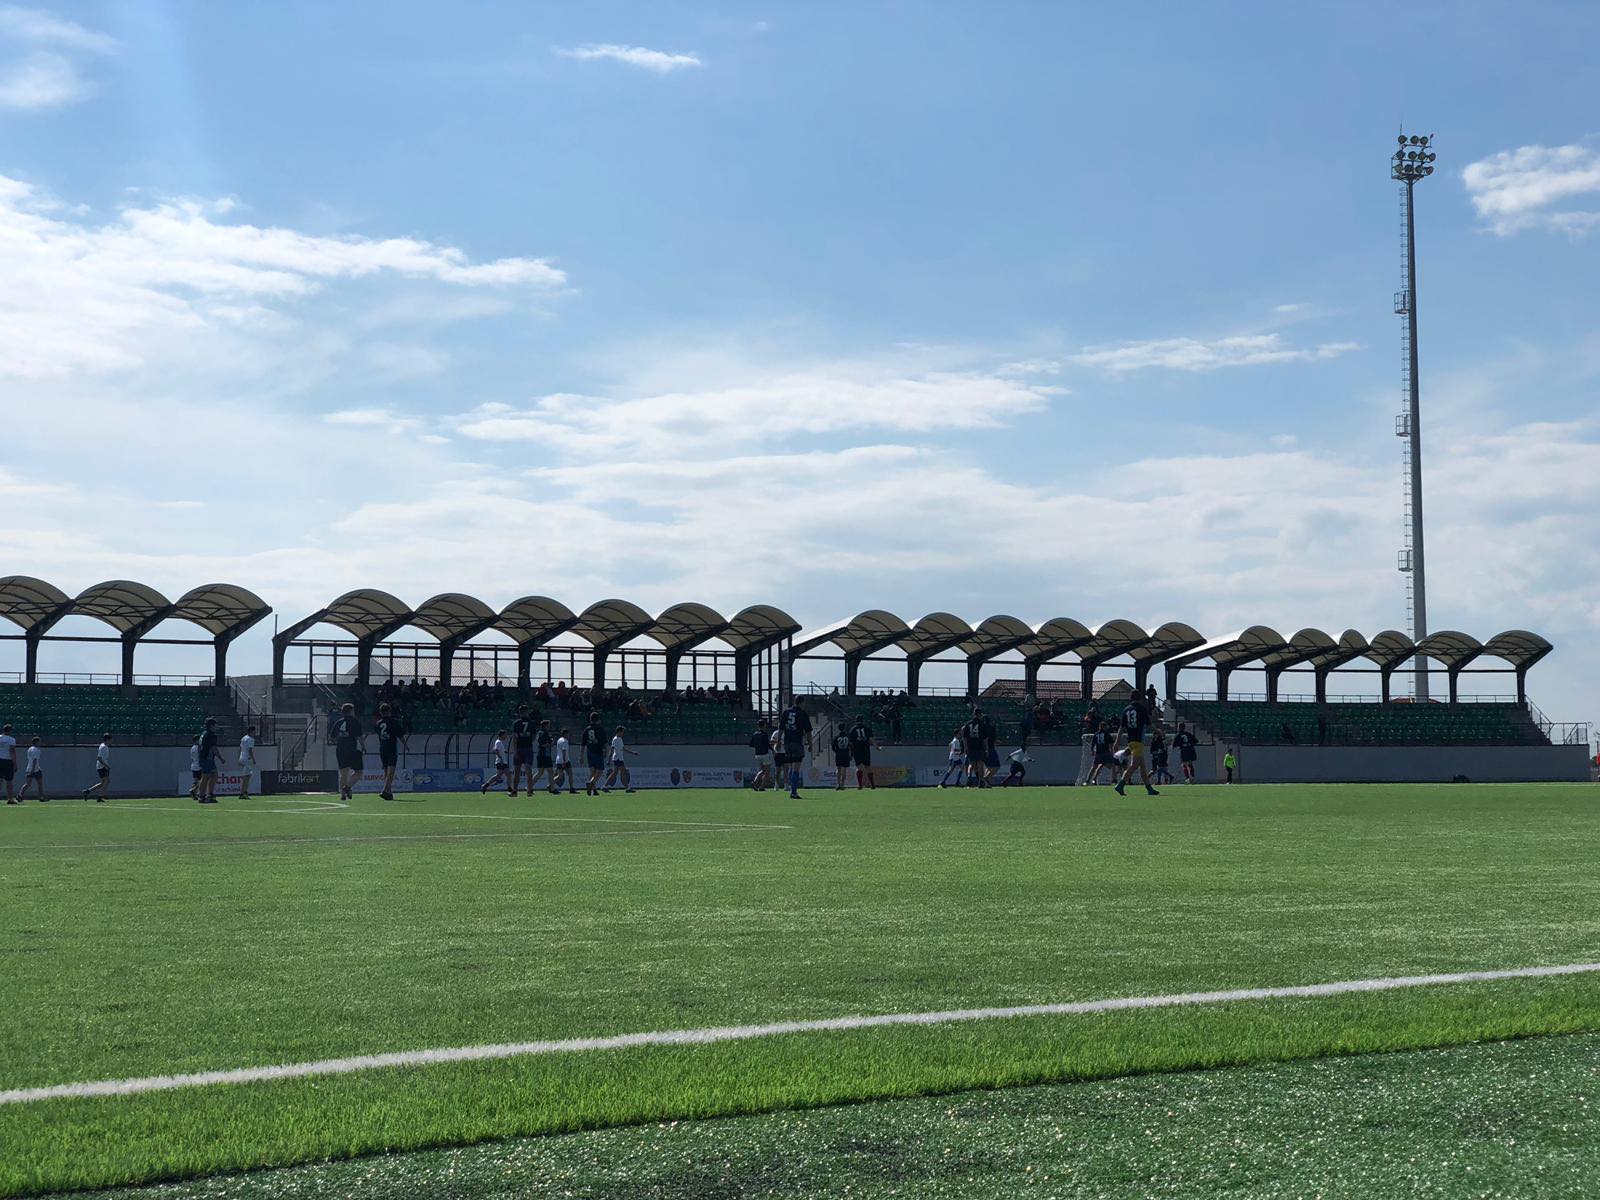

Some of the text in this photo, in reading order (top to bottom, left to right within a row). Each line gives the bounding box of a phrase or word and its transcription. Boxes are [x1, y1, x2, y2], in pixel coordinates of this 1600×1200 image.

[787, 712, 796, 725] 5
[339, 720, 347, 732] 4
[379, 722, 388, 736] 2
[522, 721, 528, 733] 7
